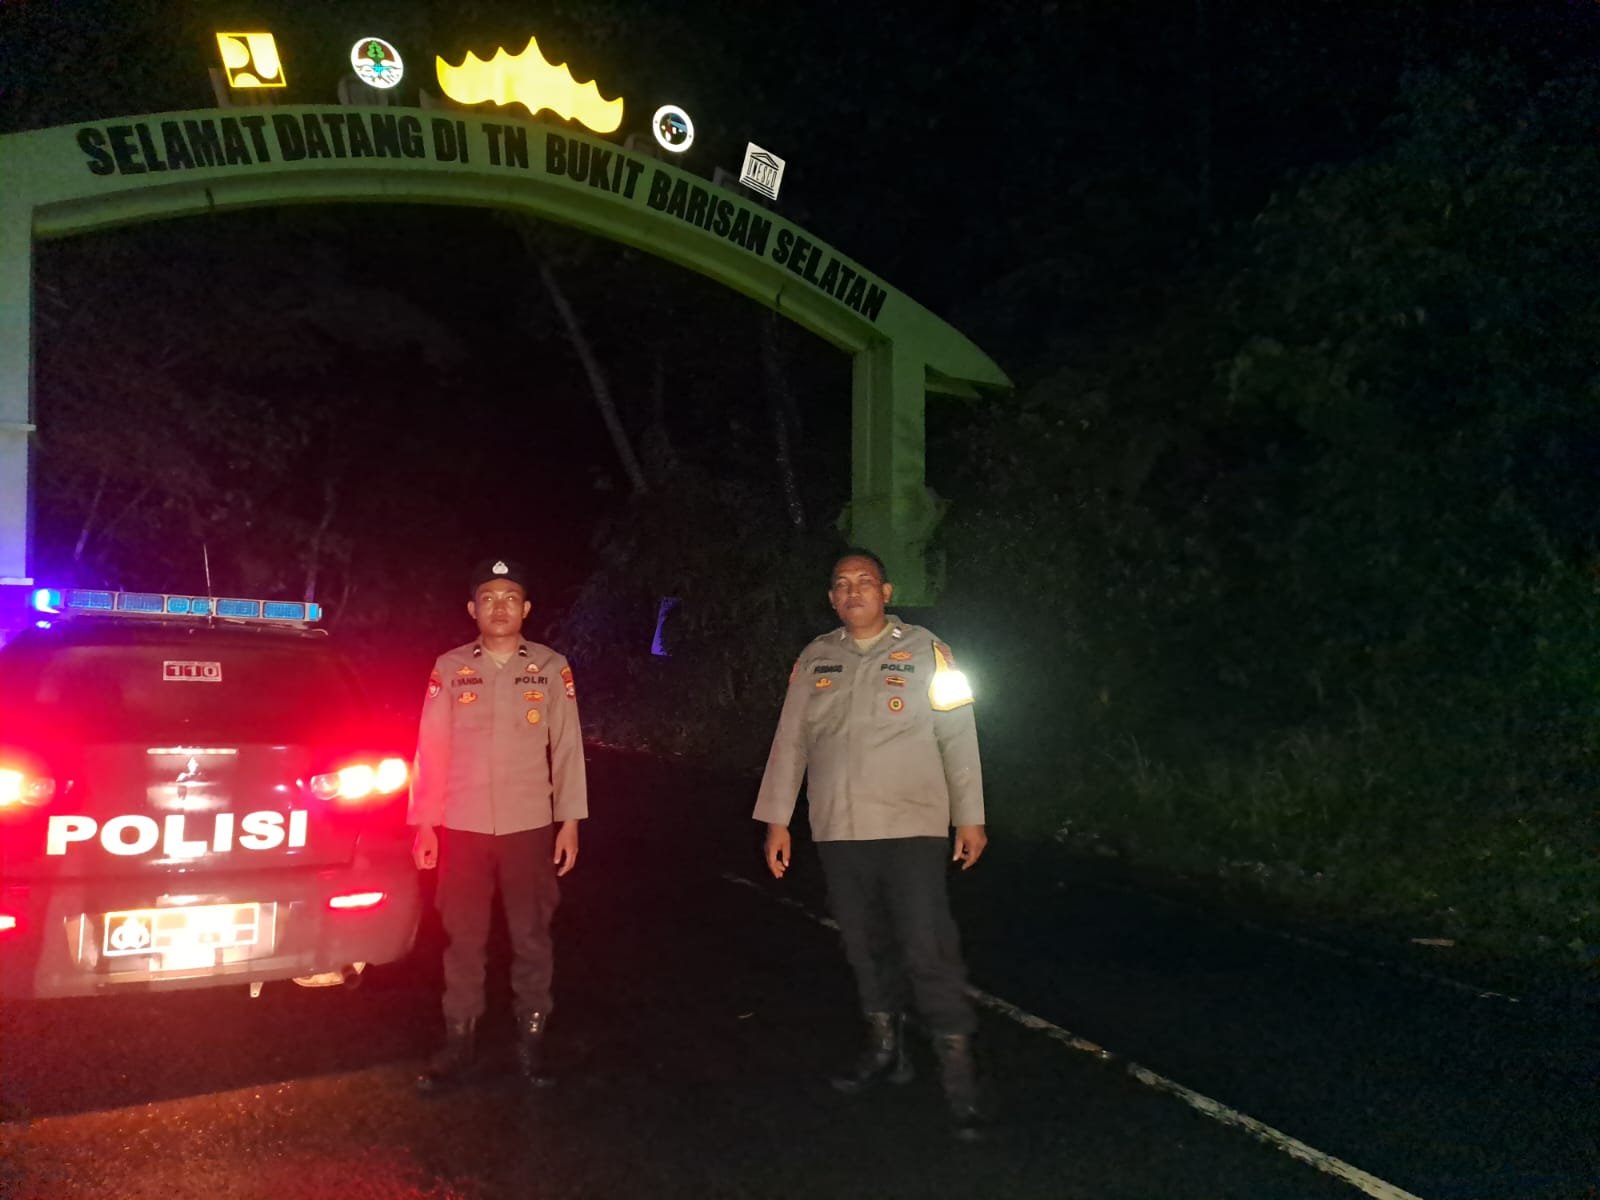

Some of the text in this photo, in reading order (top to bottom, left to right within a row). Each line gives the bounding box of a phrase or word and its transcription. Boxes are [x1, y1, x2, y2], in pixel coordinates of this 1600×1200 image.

[747, 159, 777, 188] UNESCO
[77, 114, 886, 322] SELAMAT DATANG DI TN BUKIT BARISAN SELATAN
[168, 665, 218, 678] 110
[880, 663, 915, 674] POLRI
[515, 676, 548, 685] POLRI
[47, 811, 308, 858] POLISI
